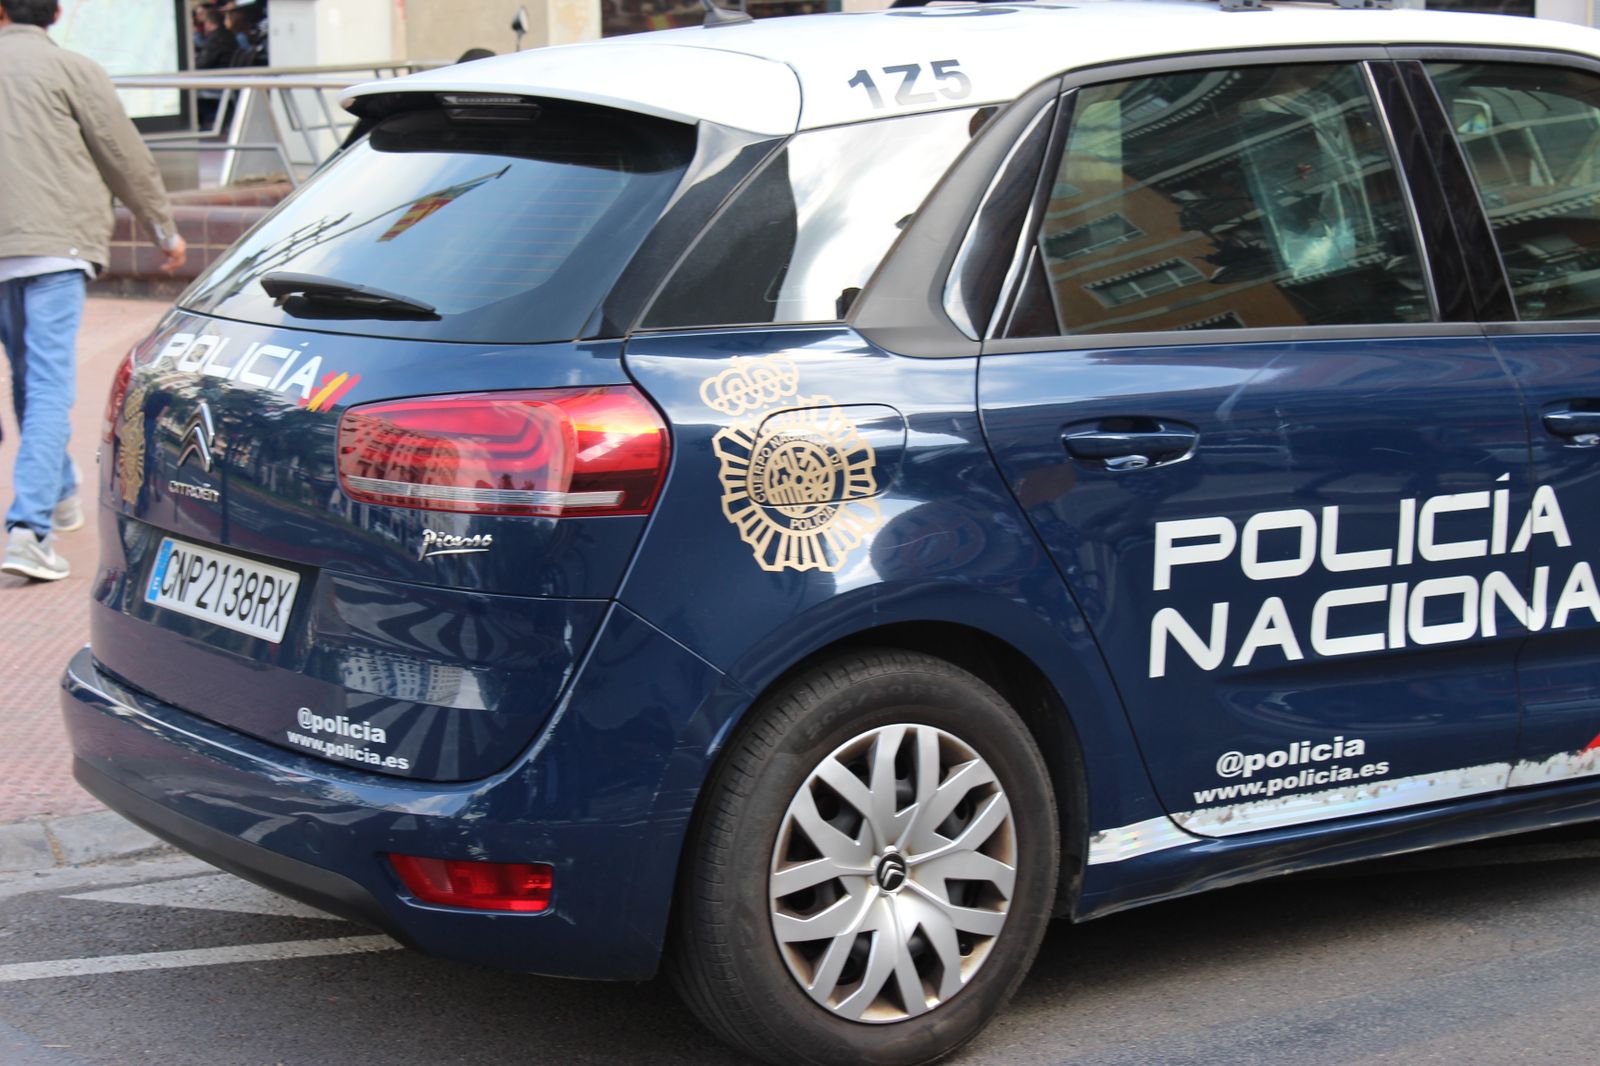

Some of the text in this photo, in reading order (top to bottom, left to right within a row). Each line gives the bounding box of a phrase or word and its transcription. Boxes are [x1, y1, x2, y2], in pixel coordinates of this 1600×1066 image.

[151, 332, 323, 400] POLICÍA
[1152, 472, 1572, 591] POLICÍA
[160, 549, 293, 633] CNP2138RX
[297, 706, 387, 744] @policia
[286, 728, 410, 771] www.policia.es
[1216, 735, 1366, 778] @policia
[1193, 758, 1390, 804] www.policia.es
